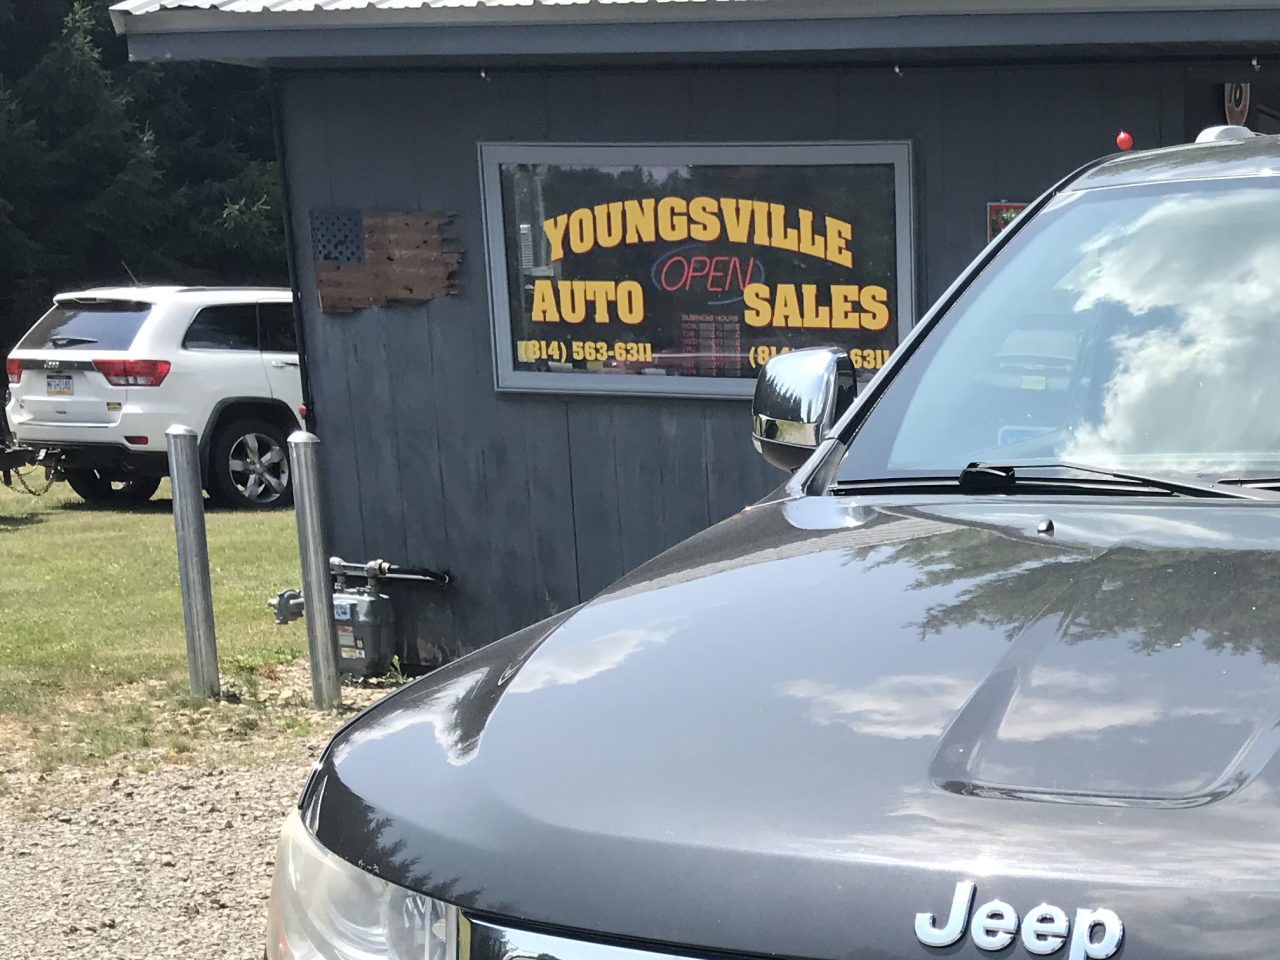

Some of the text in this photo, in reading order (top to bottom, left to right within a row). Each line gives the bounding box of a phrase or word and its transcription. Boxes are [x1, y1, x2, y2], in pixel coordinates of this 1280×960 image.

[543, 197, 853, 268] YOUNGSVILLE
[661, 256, 754, 292] OPEN
[531, 280, 890, 331] AUTO SALES
[572, 341, 652, 362] 563-6311
